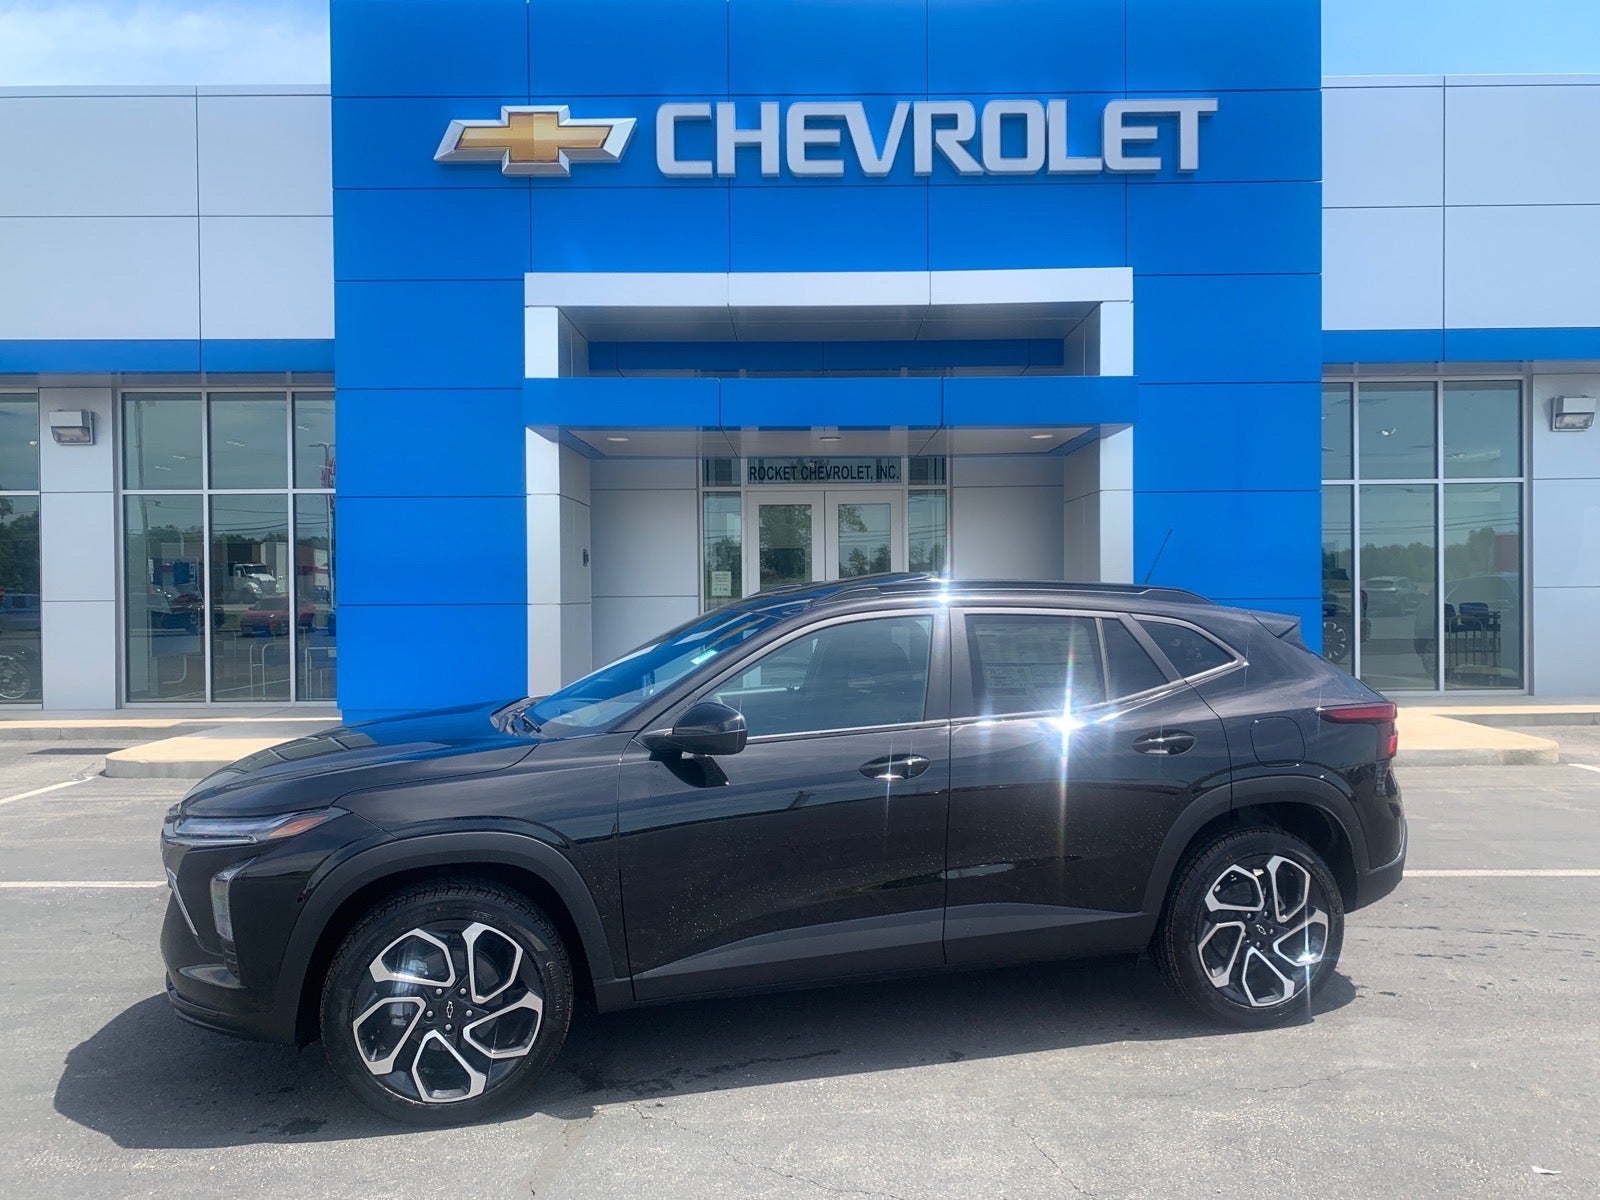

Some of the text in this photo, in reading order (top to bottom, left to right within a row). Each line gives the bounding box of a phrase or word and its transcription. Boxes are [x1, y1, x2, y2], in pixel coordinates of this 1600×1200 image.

[656, 98, 1218, 177] CHEVROLET
[750, 465, 900, 482] ROCKET CHEVROLET, INC.
